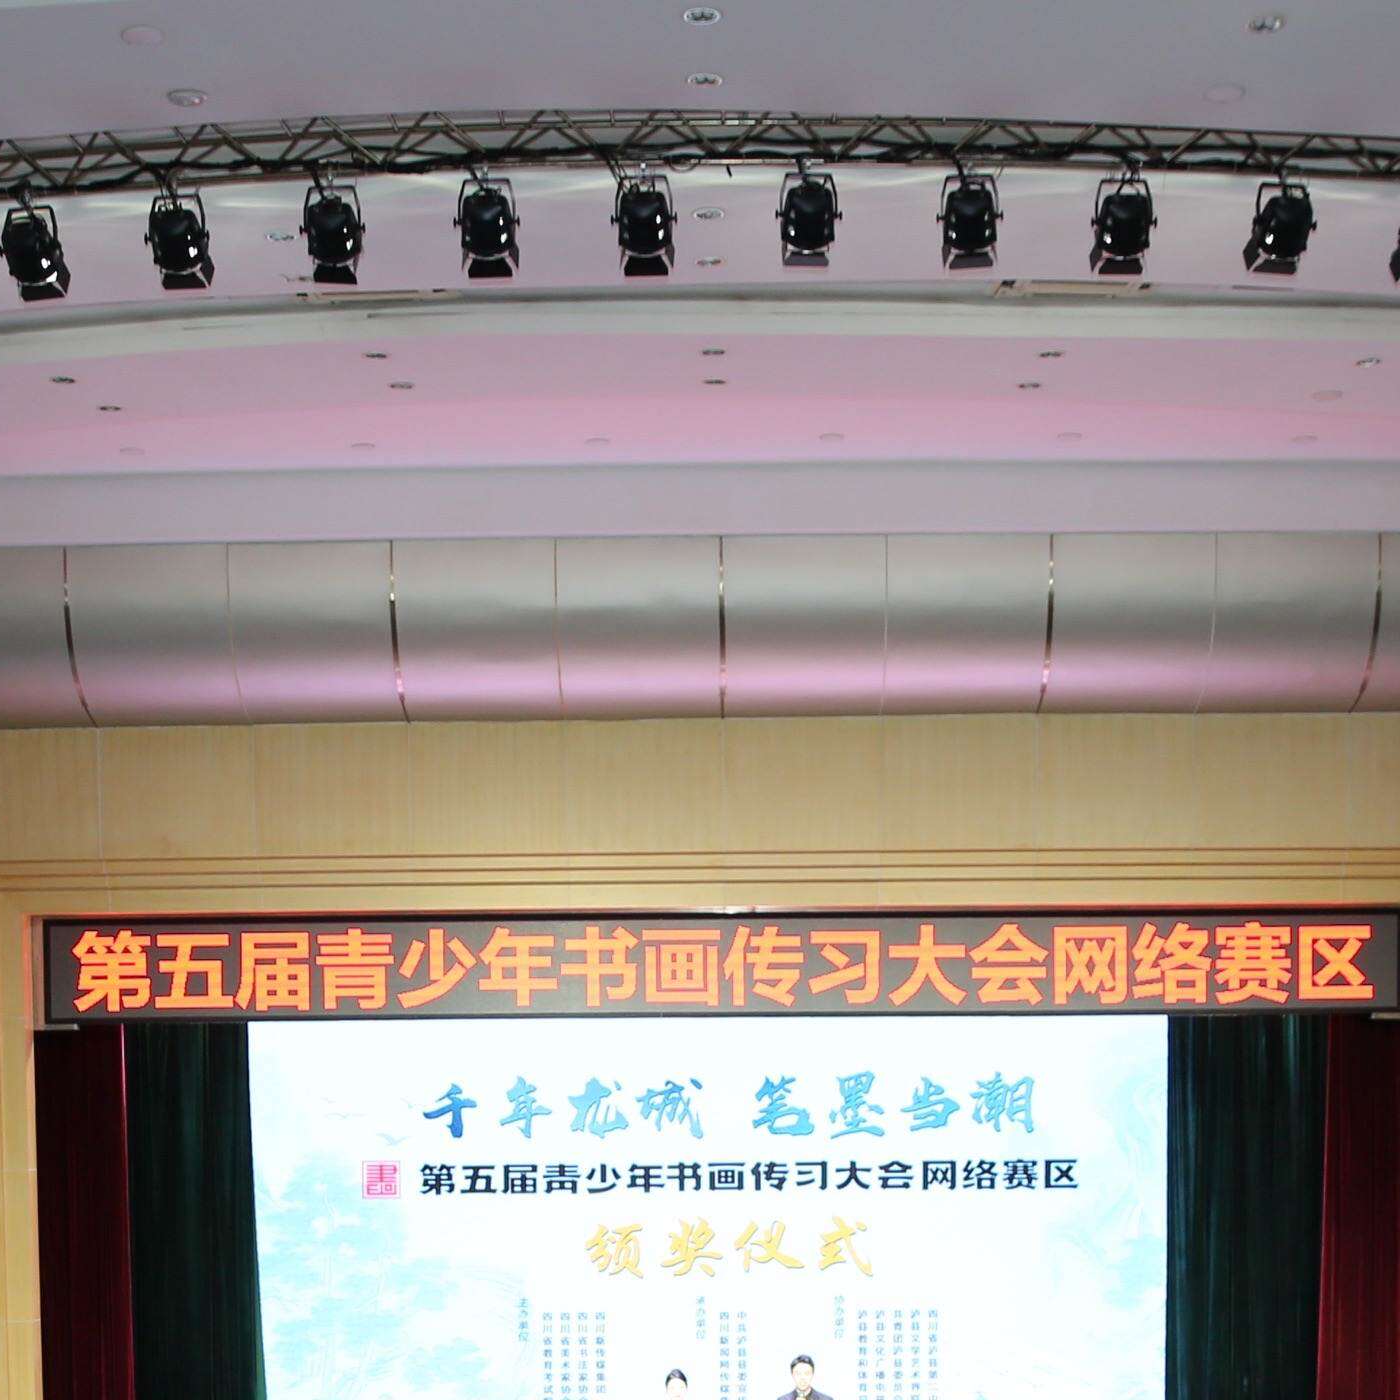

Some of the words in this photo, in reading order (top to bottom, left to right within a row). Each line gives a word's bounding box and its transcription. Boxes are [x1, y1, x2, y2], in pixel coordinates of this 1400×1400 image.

[71, 922, 1375, 1014] 第五届青少年书画传习大会网络赛区
[751, 1070, 1036, 1140] 笔墨当潮
[420, 1158, 1080, 1197] 第五届青少年书画传习大会网络赛区
[585, 1215, 874, 1280] 颁奖仪式
